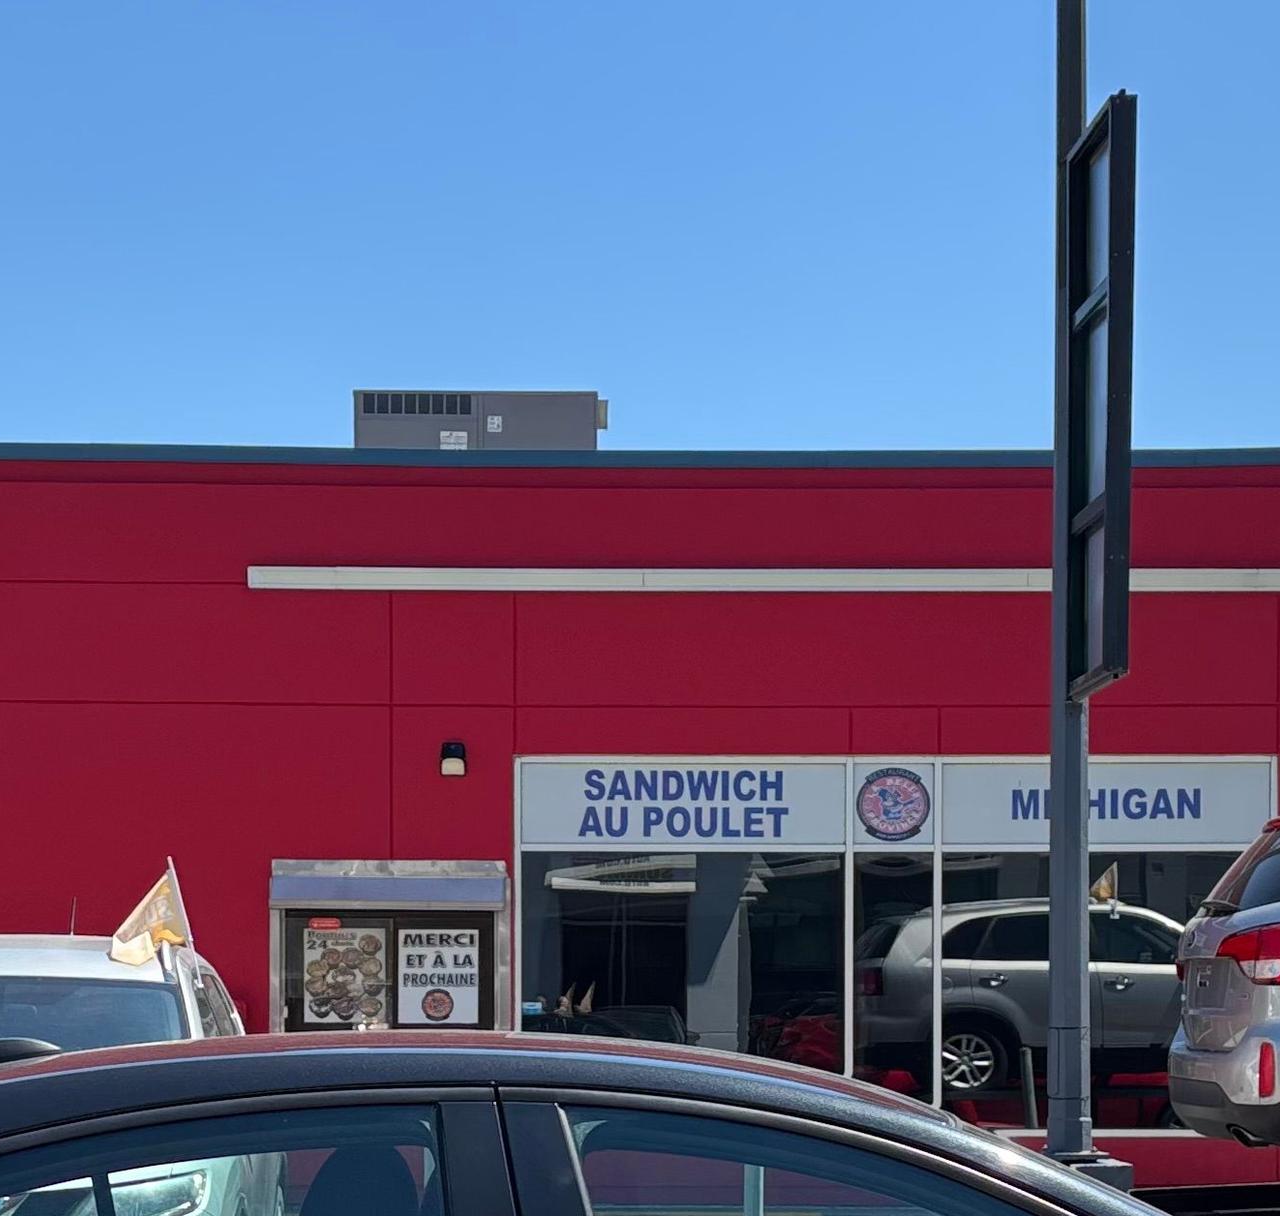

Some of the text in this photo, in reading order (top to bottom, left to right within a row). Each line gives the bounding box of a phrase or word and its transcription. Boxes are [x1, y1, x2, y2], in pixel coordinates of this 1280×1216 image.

[583, 769, 784, 801] SANDWICH
[1011, 788, 1202, 820] MIHIGAN
[578, 806, 789, 838] AU POULET
[306, 940, 328, 950] 24
[403, 933, 476, 947] MERCI
[406, 954, 427, 968] ET
[453, 954, 475, 968] LA
[403, 973, 477, 987] PROCHAINE
